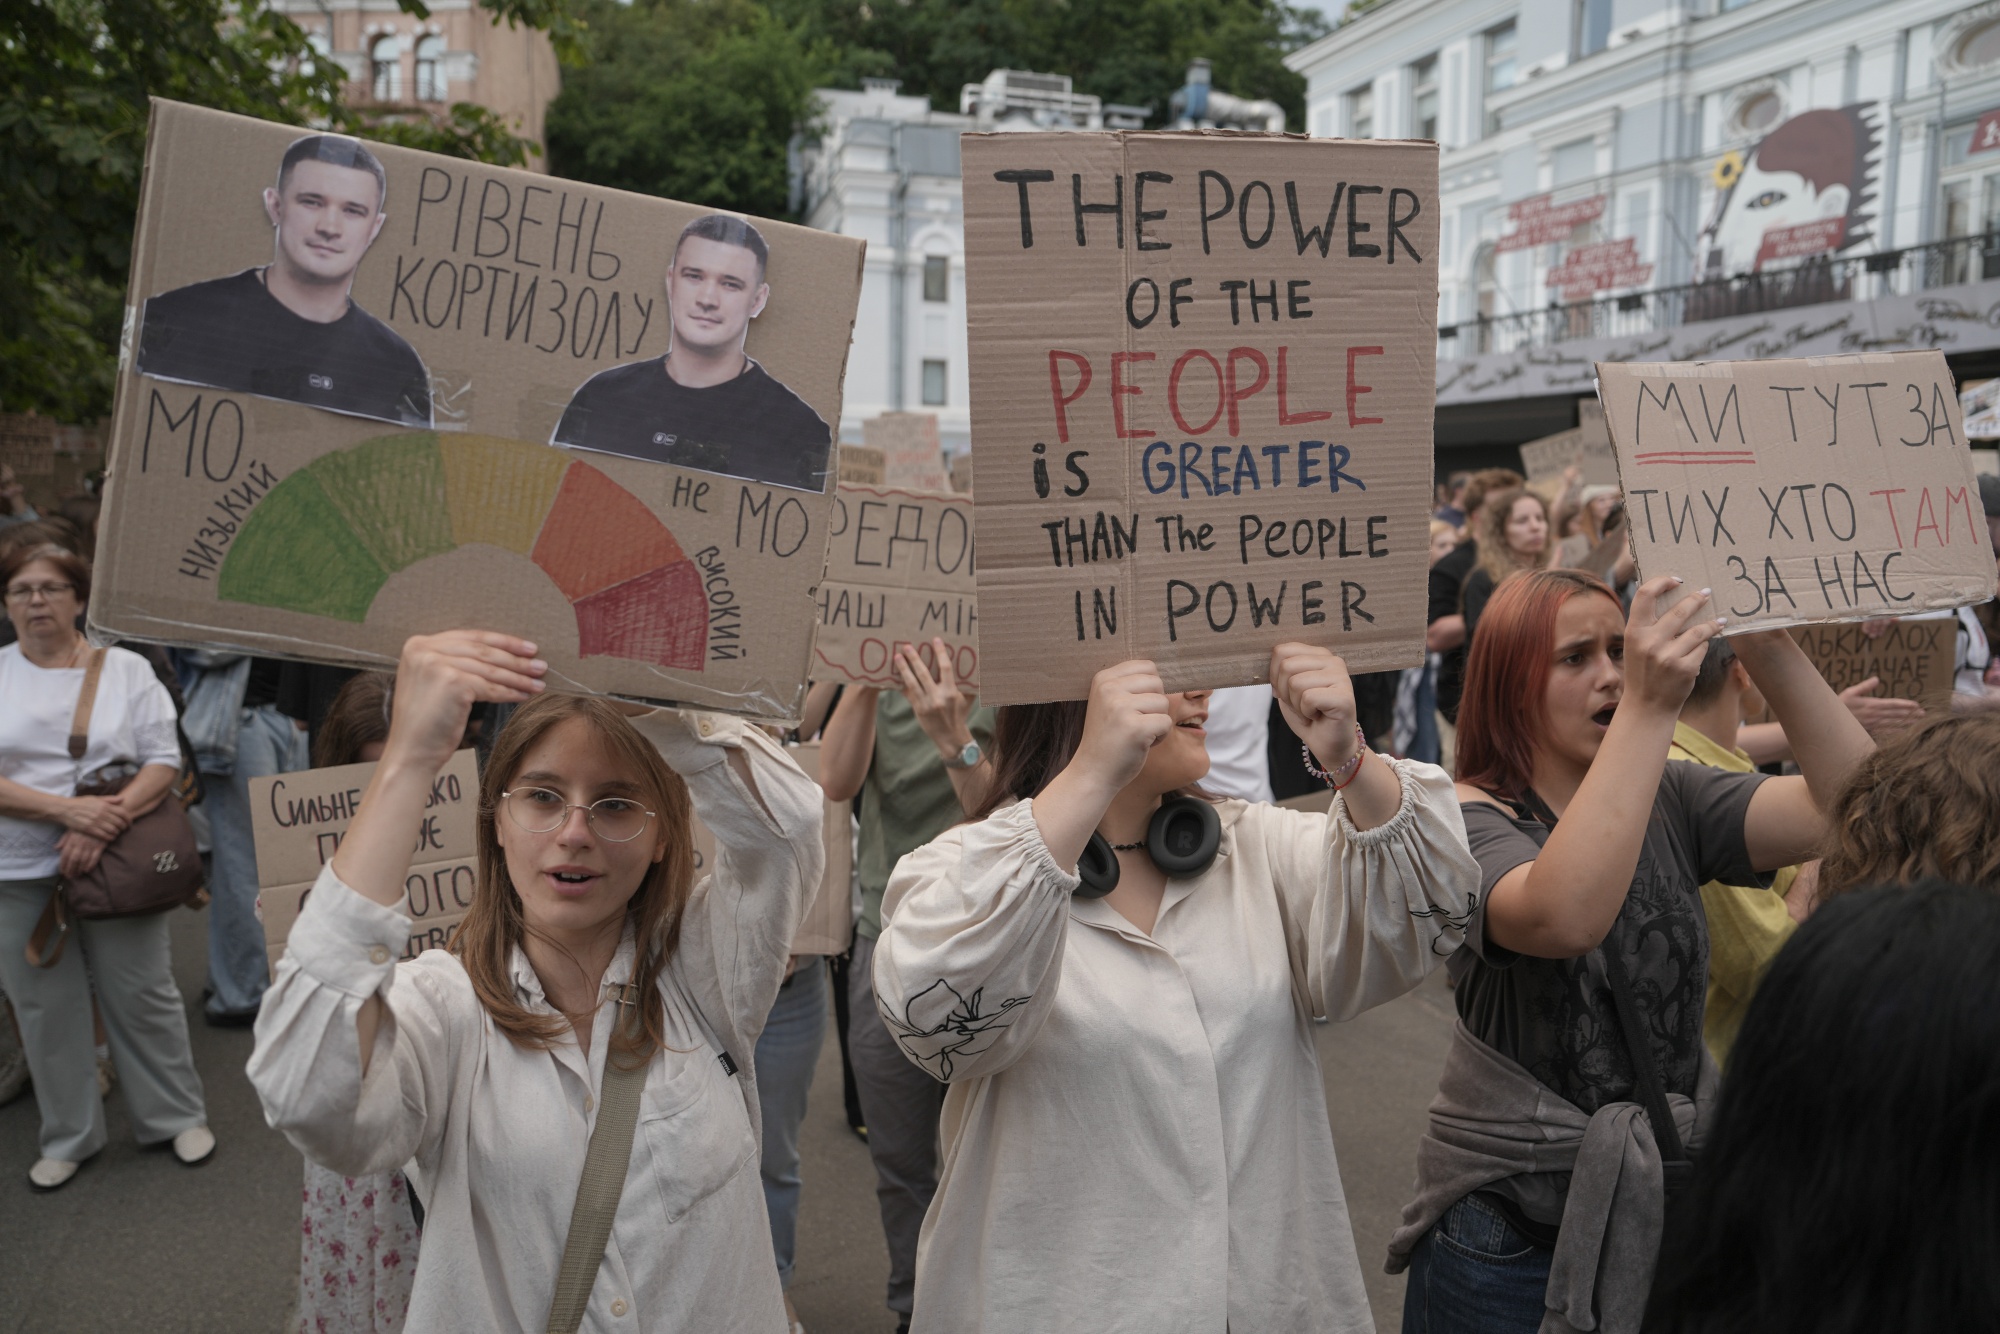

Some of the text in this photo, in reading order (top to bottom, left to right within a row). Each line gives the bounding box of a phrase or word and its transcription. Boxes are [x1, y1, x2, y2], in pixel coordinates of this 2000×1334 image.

[413, 167, 621, 281] РІВЕНЬ
[993, 168, 1174, 251] THE
[1198, 169, 1422, 264] POWER
[389, 254, 654, 360] КОРТИЗОЛУ
[1126, 277, 1314, 330] OF THE
[1048, 345, 1384, 443] PEOPLE
[1636, 380, 1746, 446] МИ
[1768, 382, 1888, 447] ТУТ
[1899, 381, 1956, 447] ЗА
[142, 387, 245, 483] МО
[1142, 440, 1367, 499] GREATER
[736, 486, 809, 558] МО
[1041, 510, 1139, 567] THAN
[1629, 482, 1979, 549] ТИХ ХТО ТАМ
[1074, 579, 1375, 642] IN POWER
[1725, 550, 1916, 618] ЗА НАС
